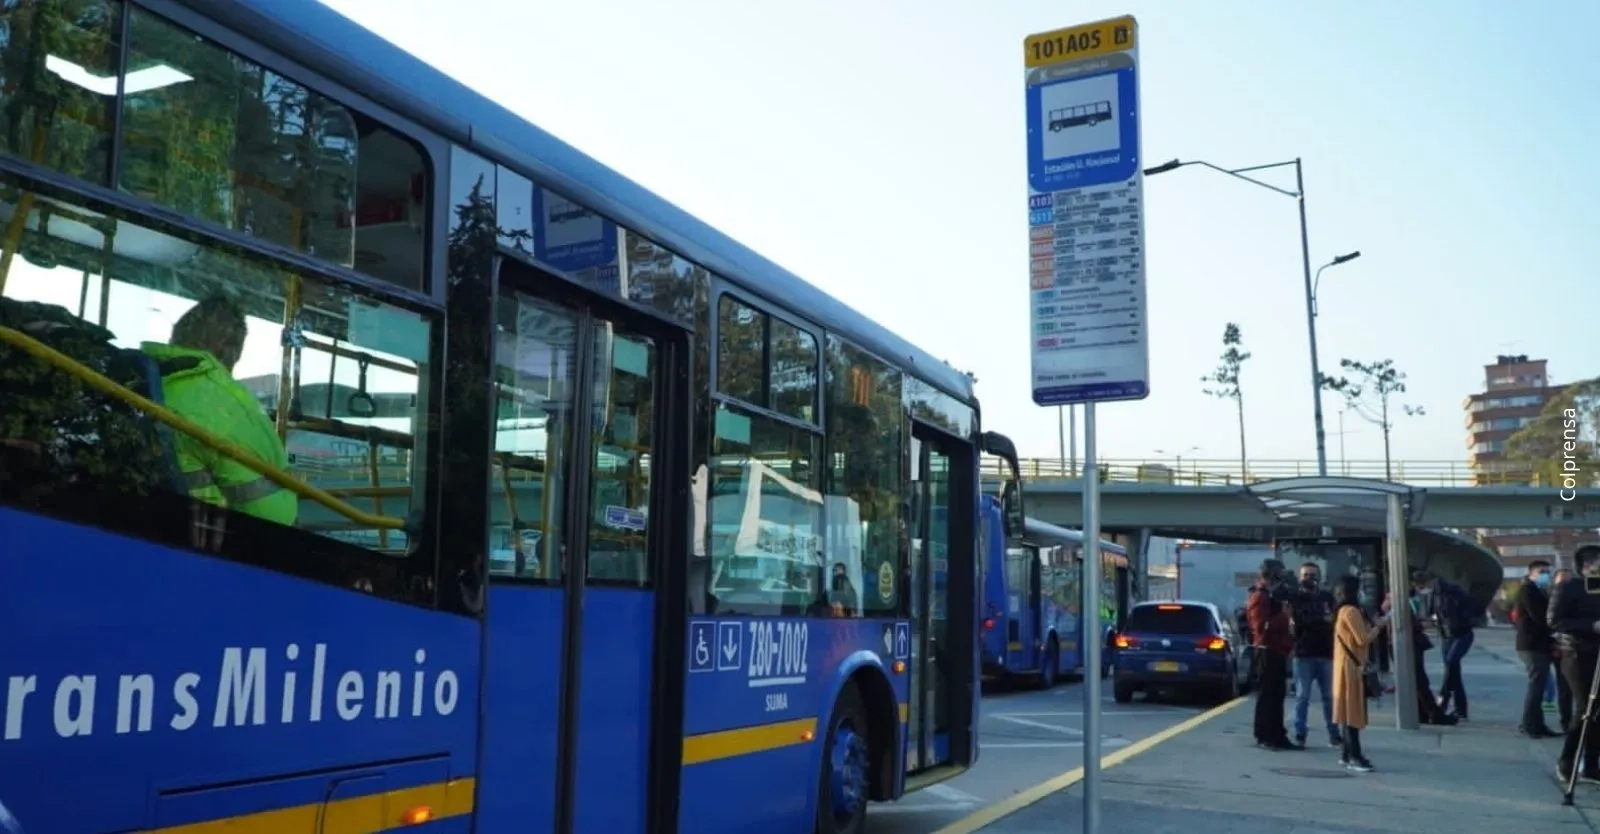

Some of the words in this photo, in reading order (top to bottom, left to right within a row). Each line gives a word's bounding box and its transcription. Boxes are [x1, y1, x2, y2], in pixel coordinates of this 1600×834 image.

[1032, 30, 1101, 60] 101A05
[748, 621, 809, 677] Z80-7002
[4, 643, 459, 740] ransMilenio
[765, 692, 789, 712] SUMA
